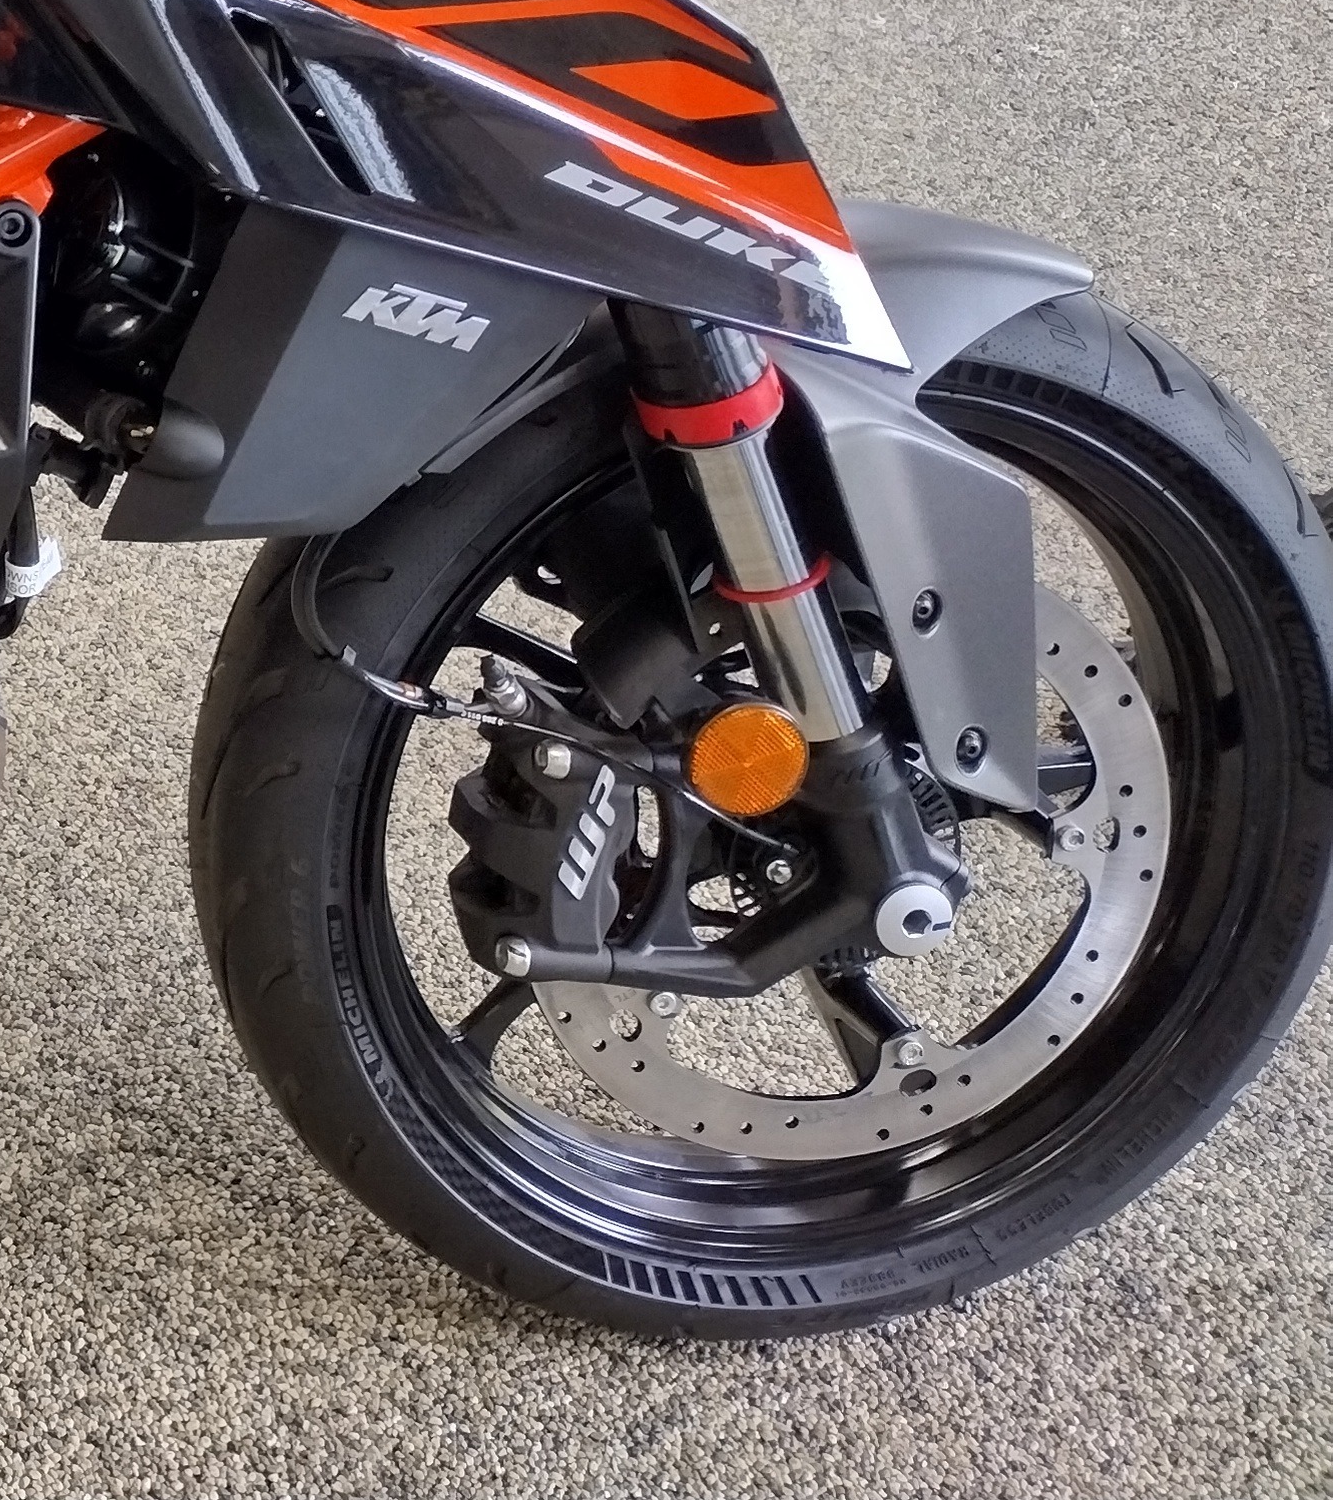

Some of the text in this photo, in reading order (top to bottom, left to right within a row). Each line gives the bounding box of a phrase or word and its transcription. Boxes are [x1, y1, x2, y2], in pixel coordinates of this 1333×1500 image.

[342, 283, 490, 353] KTM
[557, 764, 615, 900] WP
[331, 915, 379, 1066] MICHELIN
